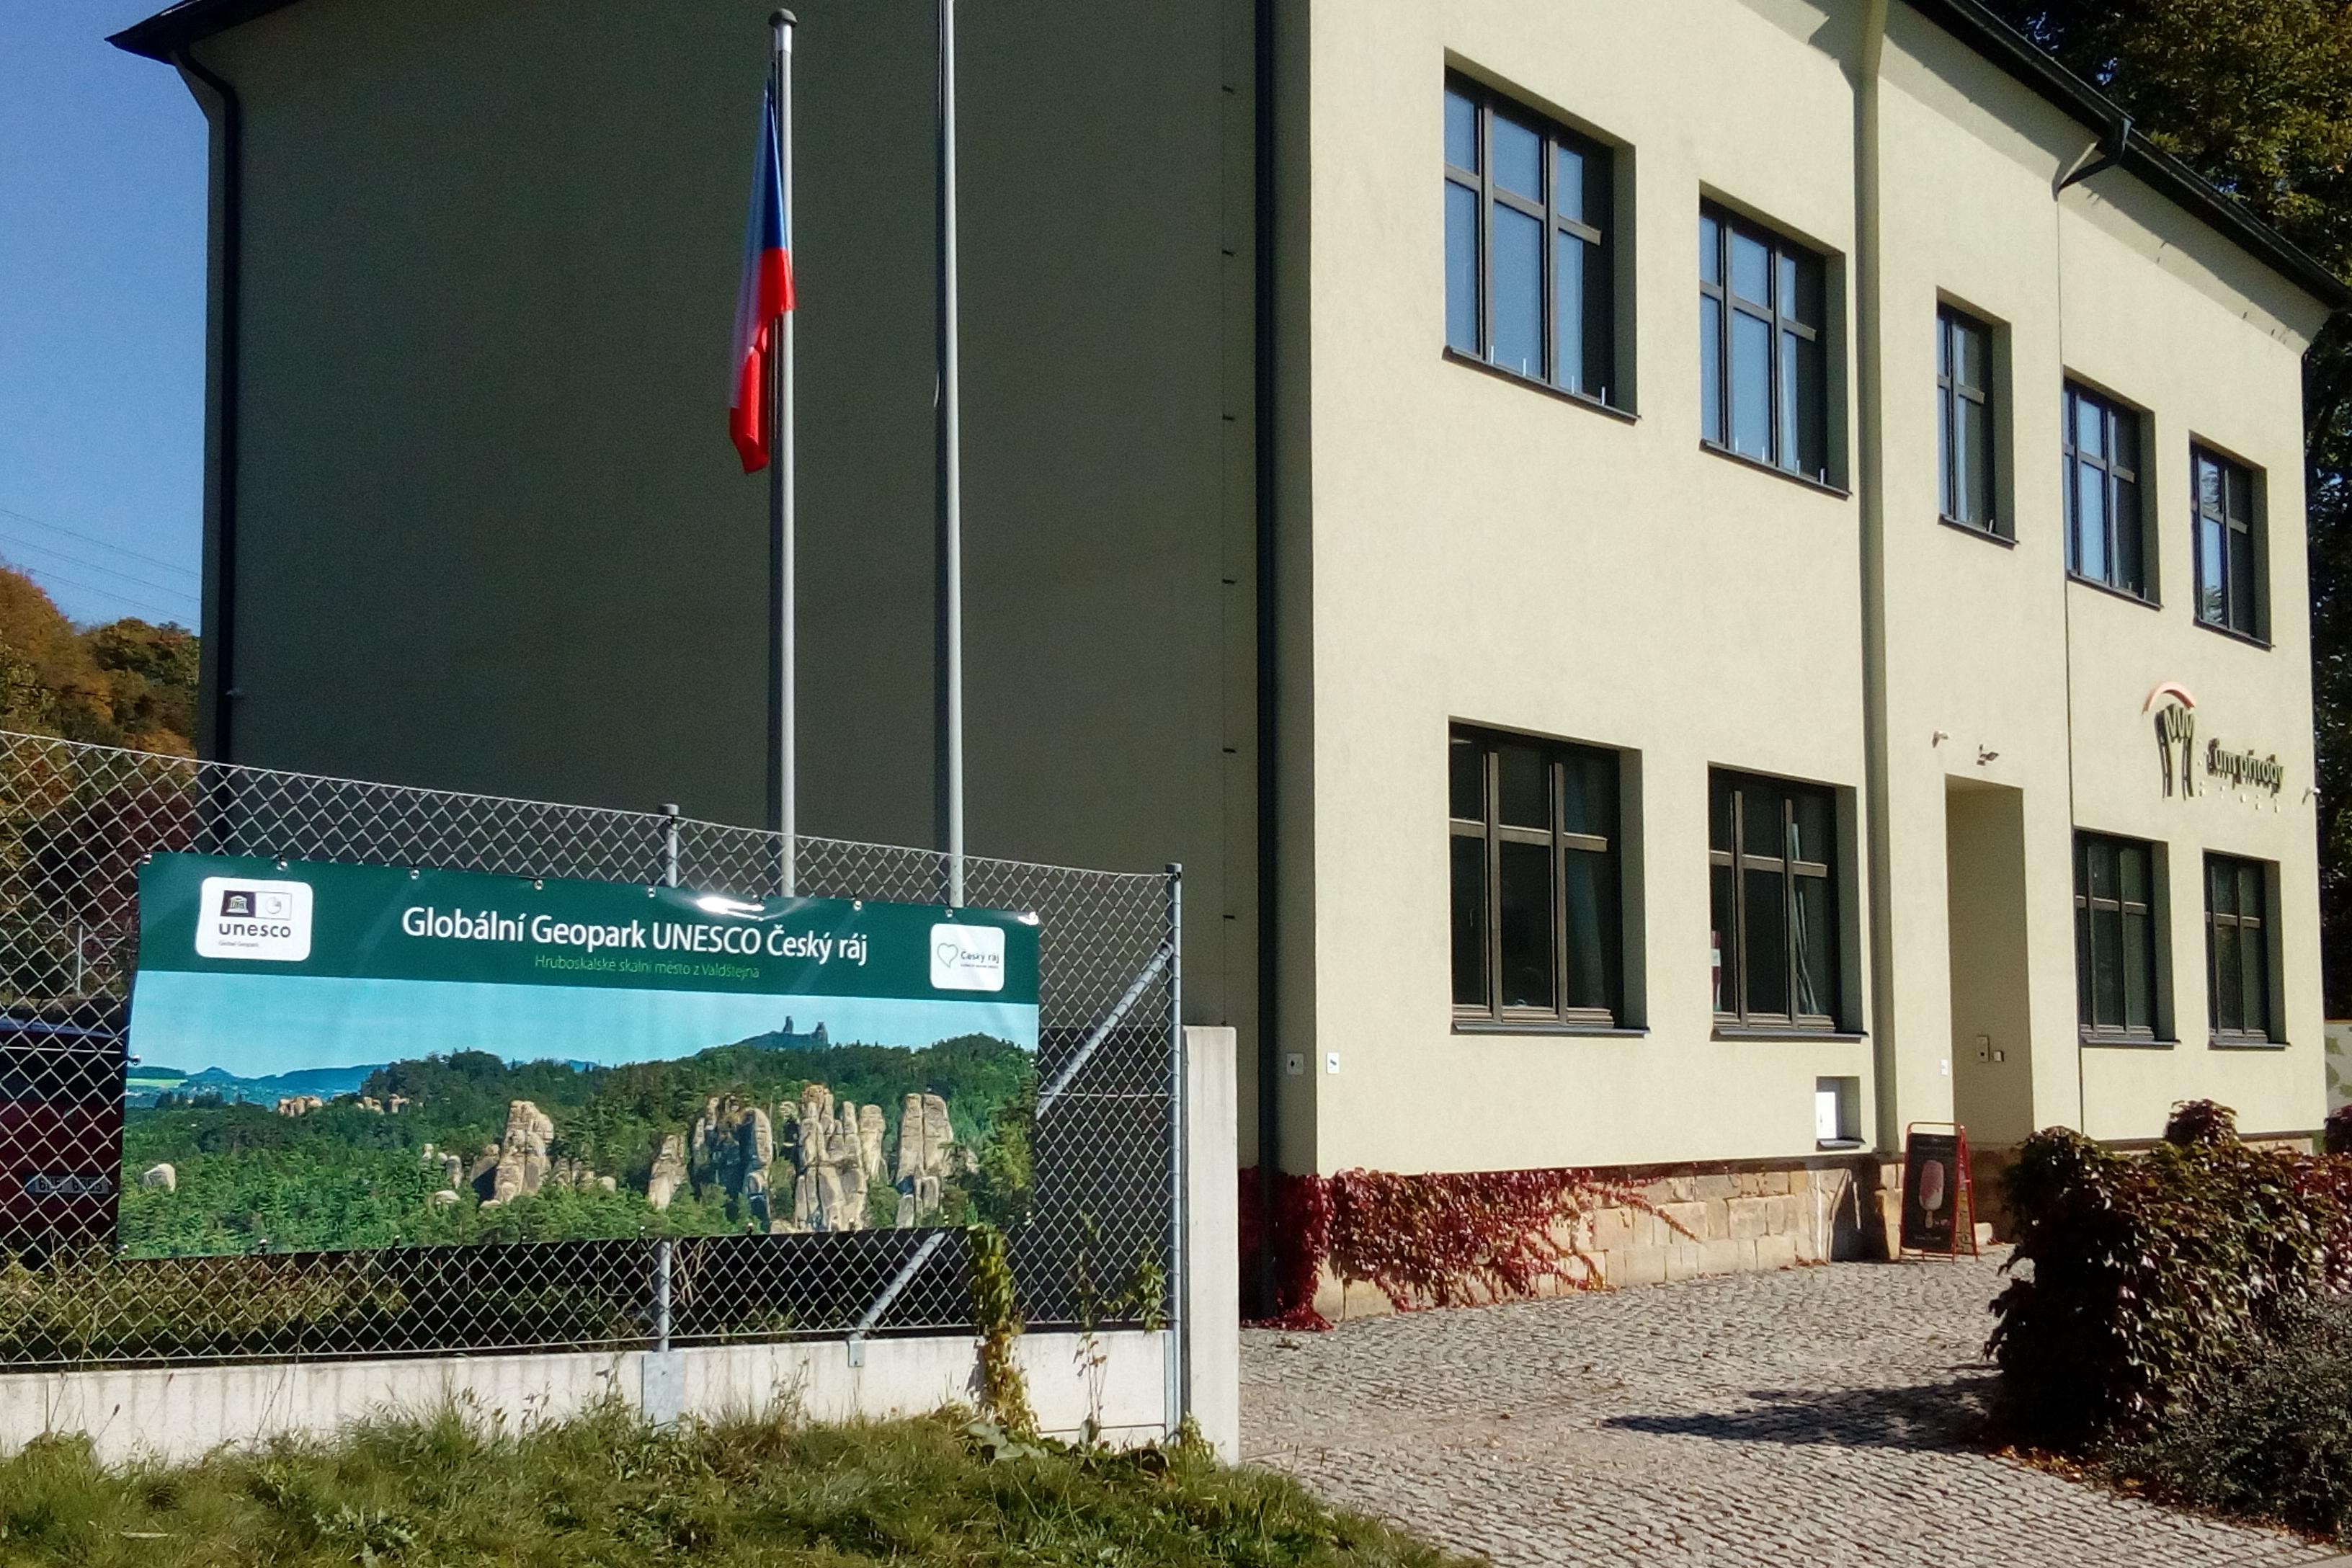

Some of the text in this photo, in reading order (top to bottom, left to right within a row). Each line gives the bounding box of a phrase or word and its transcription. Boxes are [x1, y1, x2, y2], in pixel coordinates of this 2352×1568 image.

[219, 923, 291, 937] unesco
[402, 906, 867, 966] Globální Geopark UNESCO Český ráj
[693, 965, 699, 976] z
